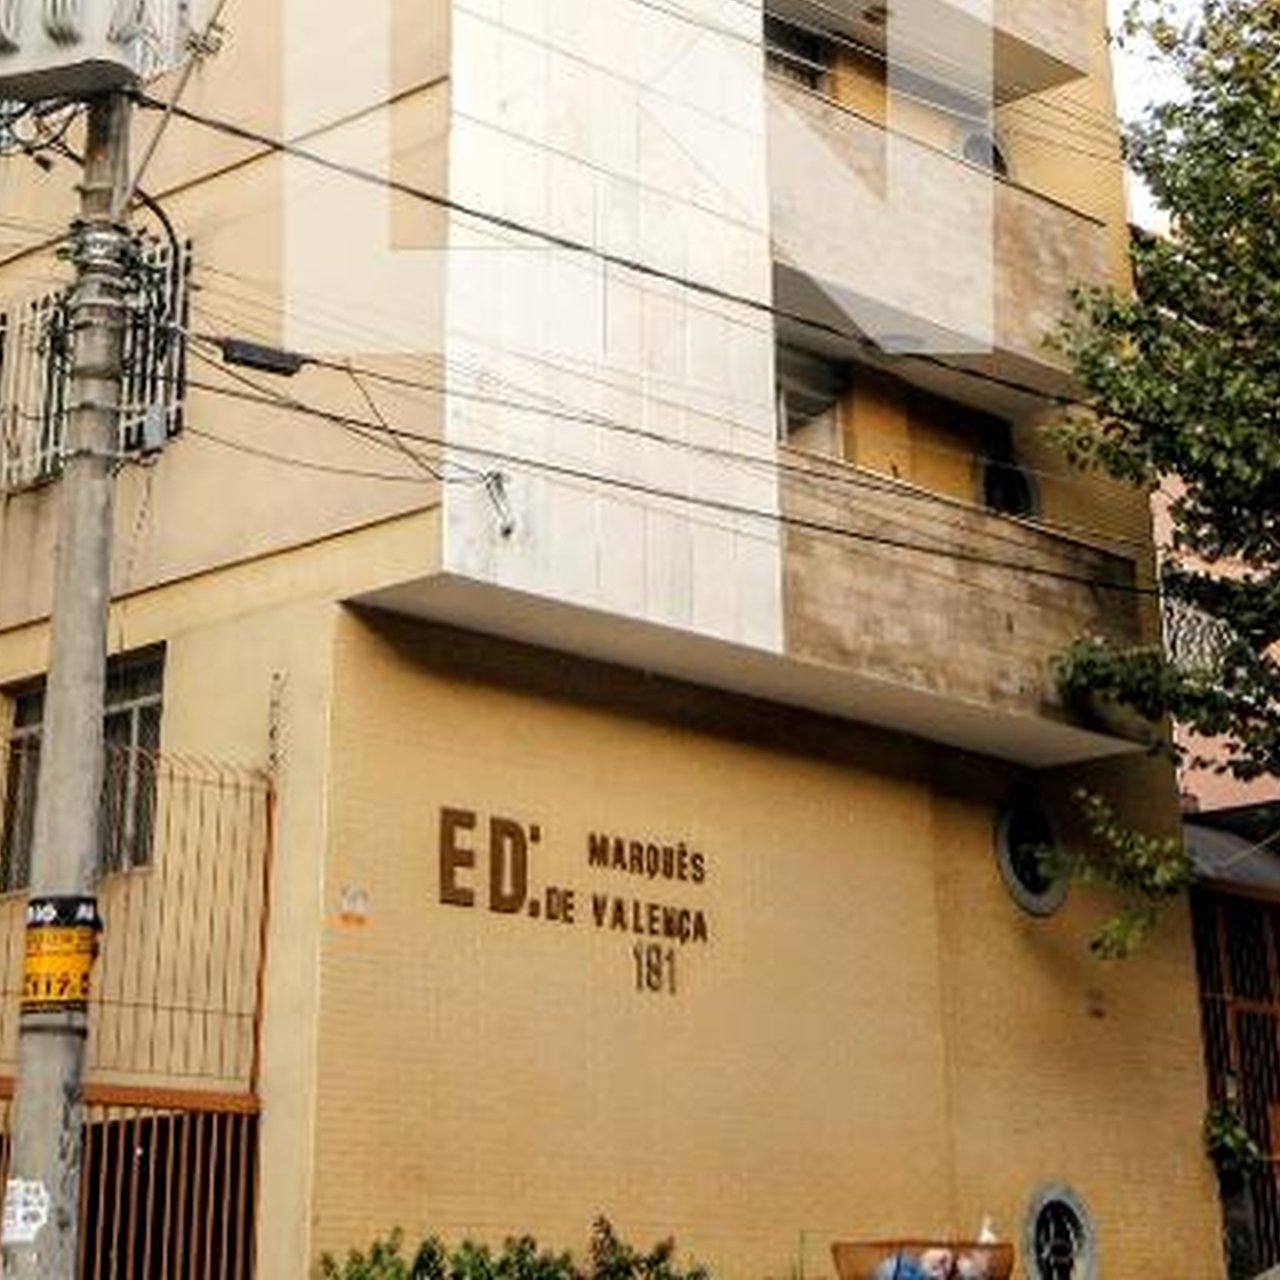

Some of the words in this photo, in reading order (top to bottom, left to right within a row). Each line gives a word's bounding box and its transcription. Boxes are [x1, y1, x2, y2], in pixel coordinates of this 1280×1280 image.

[588, 832, 705, 883] MARQUÊS
[545, 886, 575, 924] DE
[592, 894, 708, 945] VALENÇA
[633, 942, 676, 994] 181
